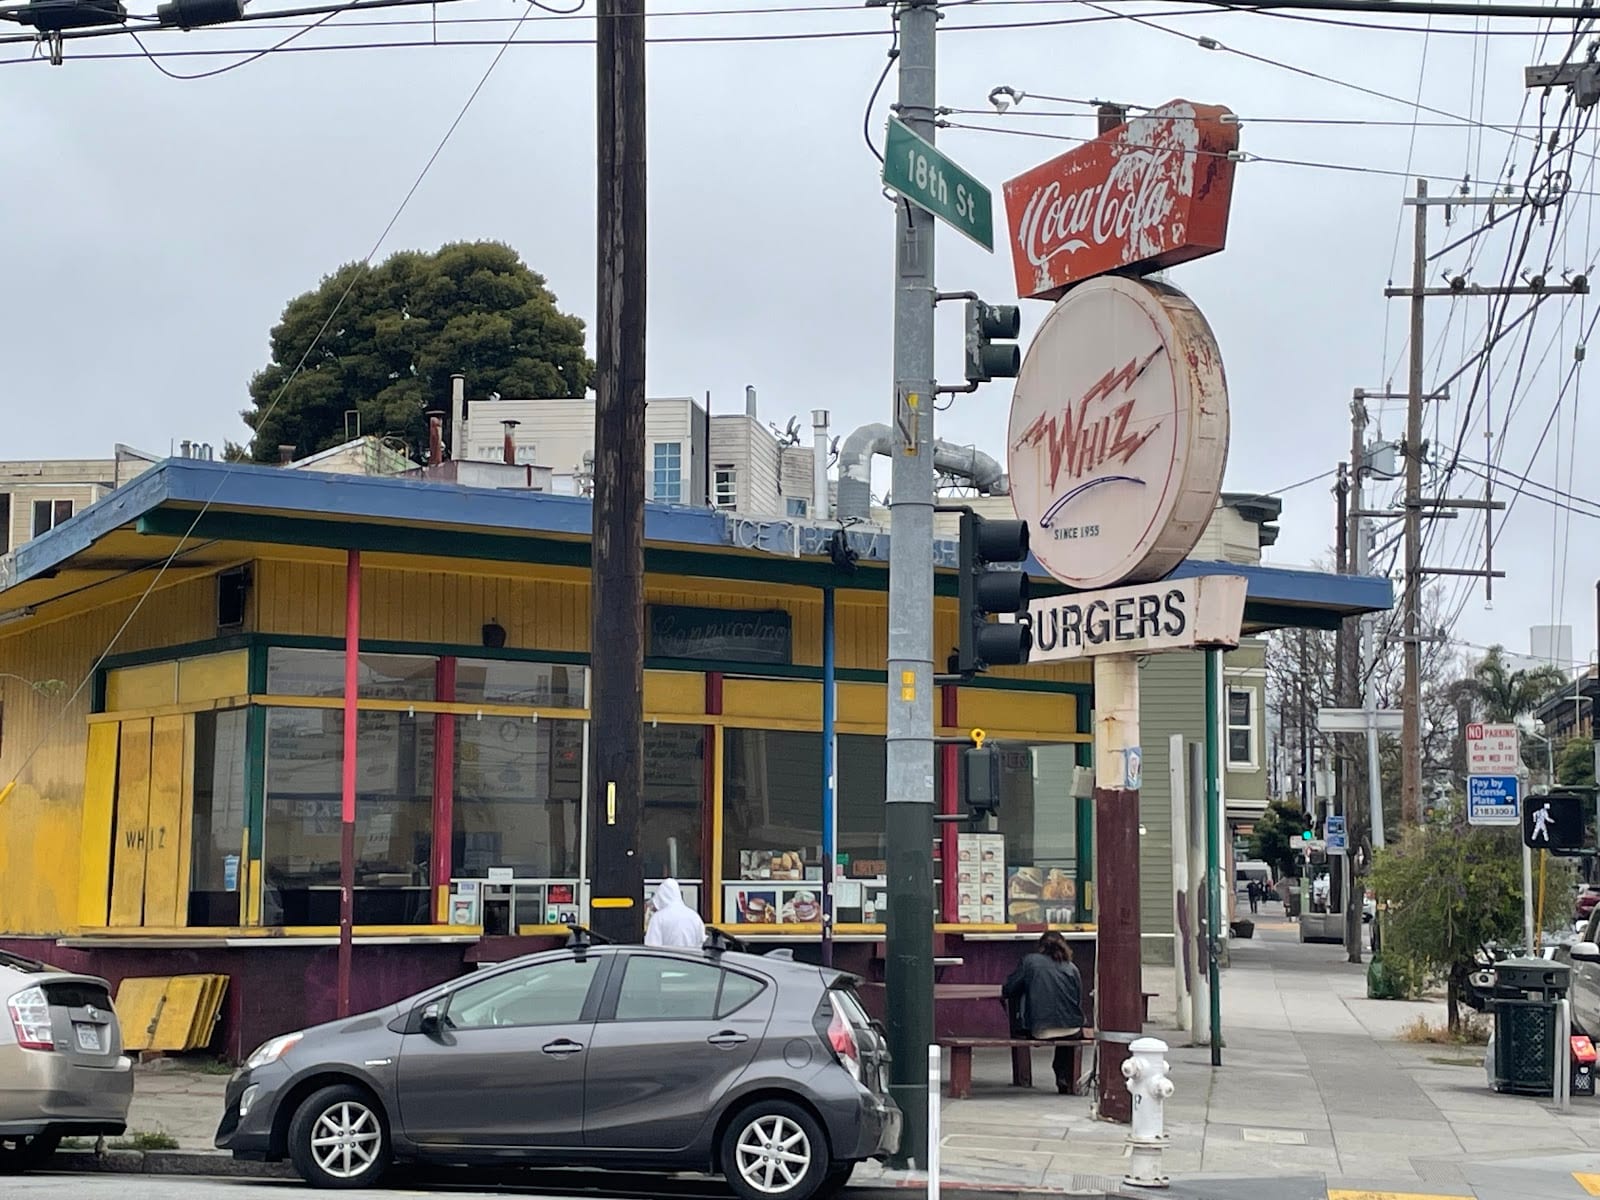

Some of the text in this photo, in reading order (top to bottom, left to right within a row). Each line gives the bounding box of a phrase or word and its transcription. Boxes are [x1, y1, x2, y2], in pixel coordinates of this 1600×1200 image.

[906, 149, 976, 225] 18th St
[732, 518, 771, 551] ICE
[1054, 524, 1100, 540] SINCE 1955
[1015, 589, 1186, 652] BURGERS
[1468, 726, 1515, 739] NO PARKING
[1471, 778, 1503, 789] Pay by
[1472, 788, 1507, 796] License
[1472, 796, 1497, 805] Plate
[125, 826, 165, 851] WHIZ
